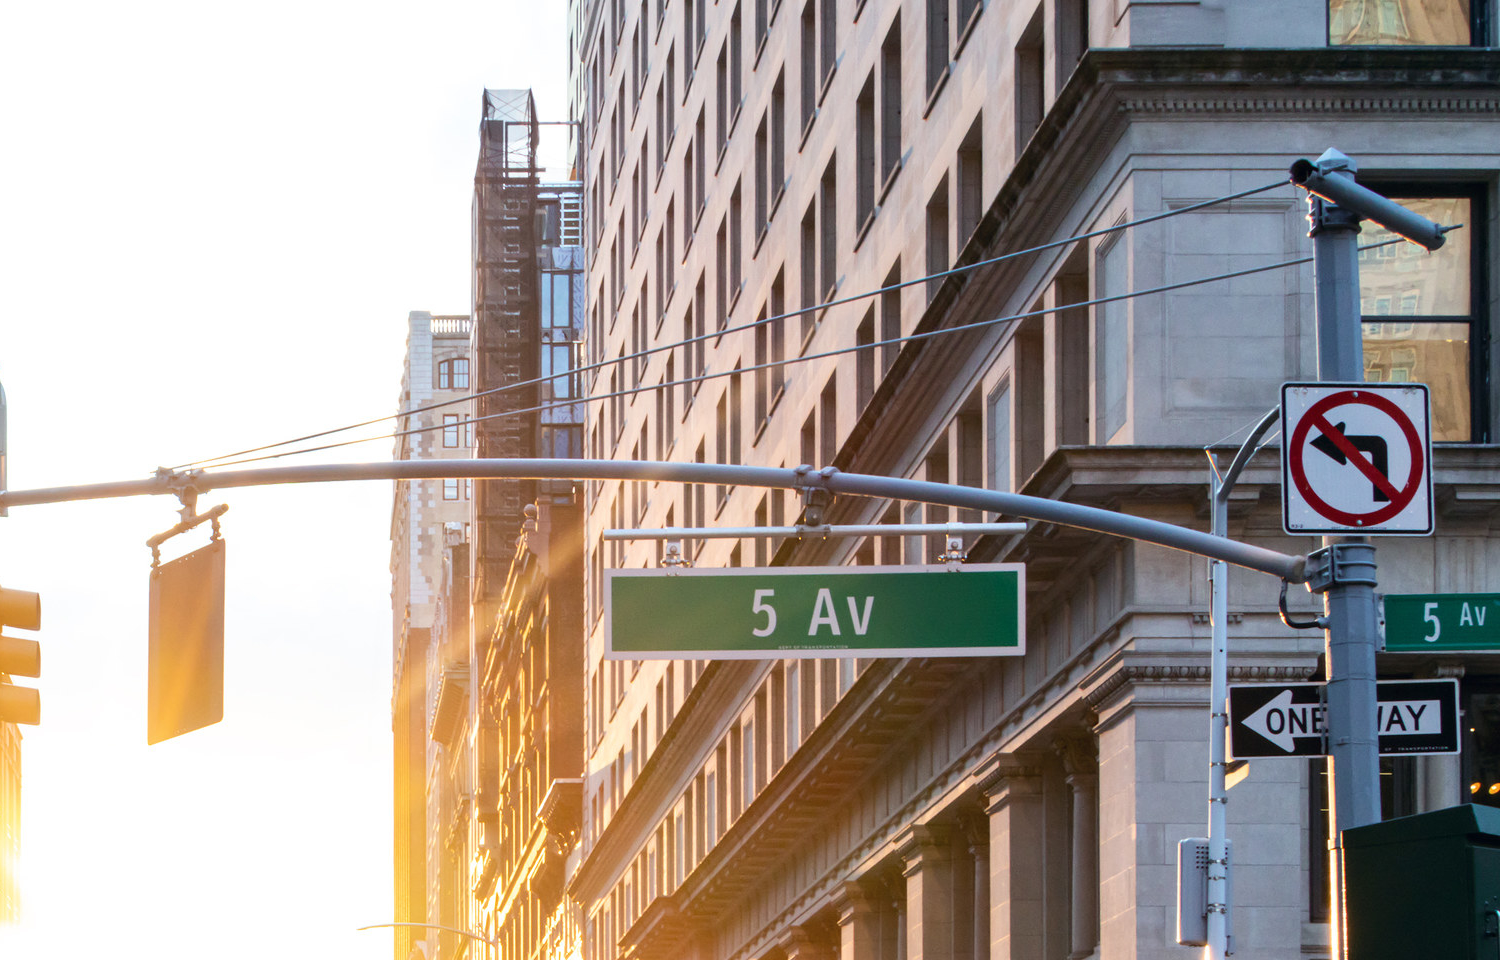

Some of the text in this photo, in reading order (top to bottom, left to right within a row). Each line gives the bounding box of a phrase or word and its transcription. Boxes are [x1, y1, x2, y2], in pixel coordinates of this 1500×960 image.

[752, 588, 874, 637] 5 Av
[1423, 602, 1486, 643] 5 Av
[1265, 703, 1428, 735] ONE AY
